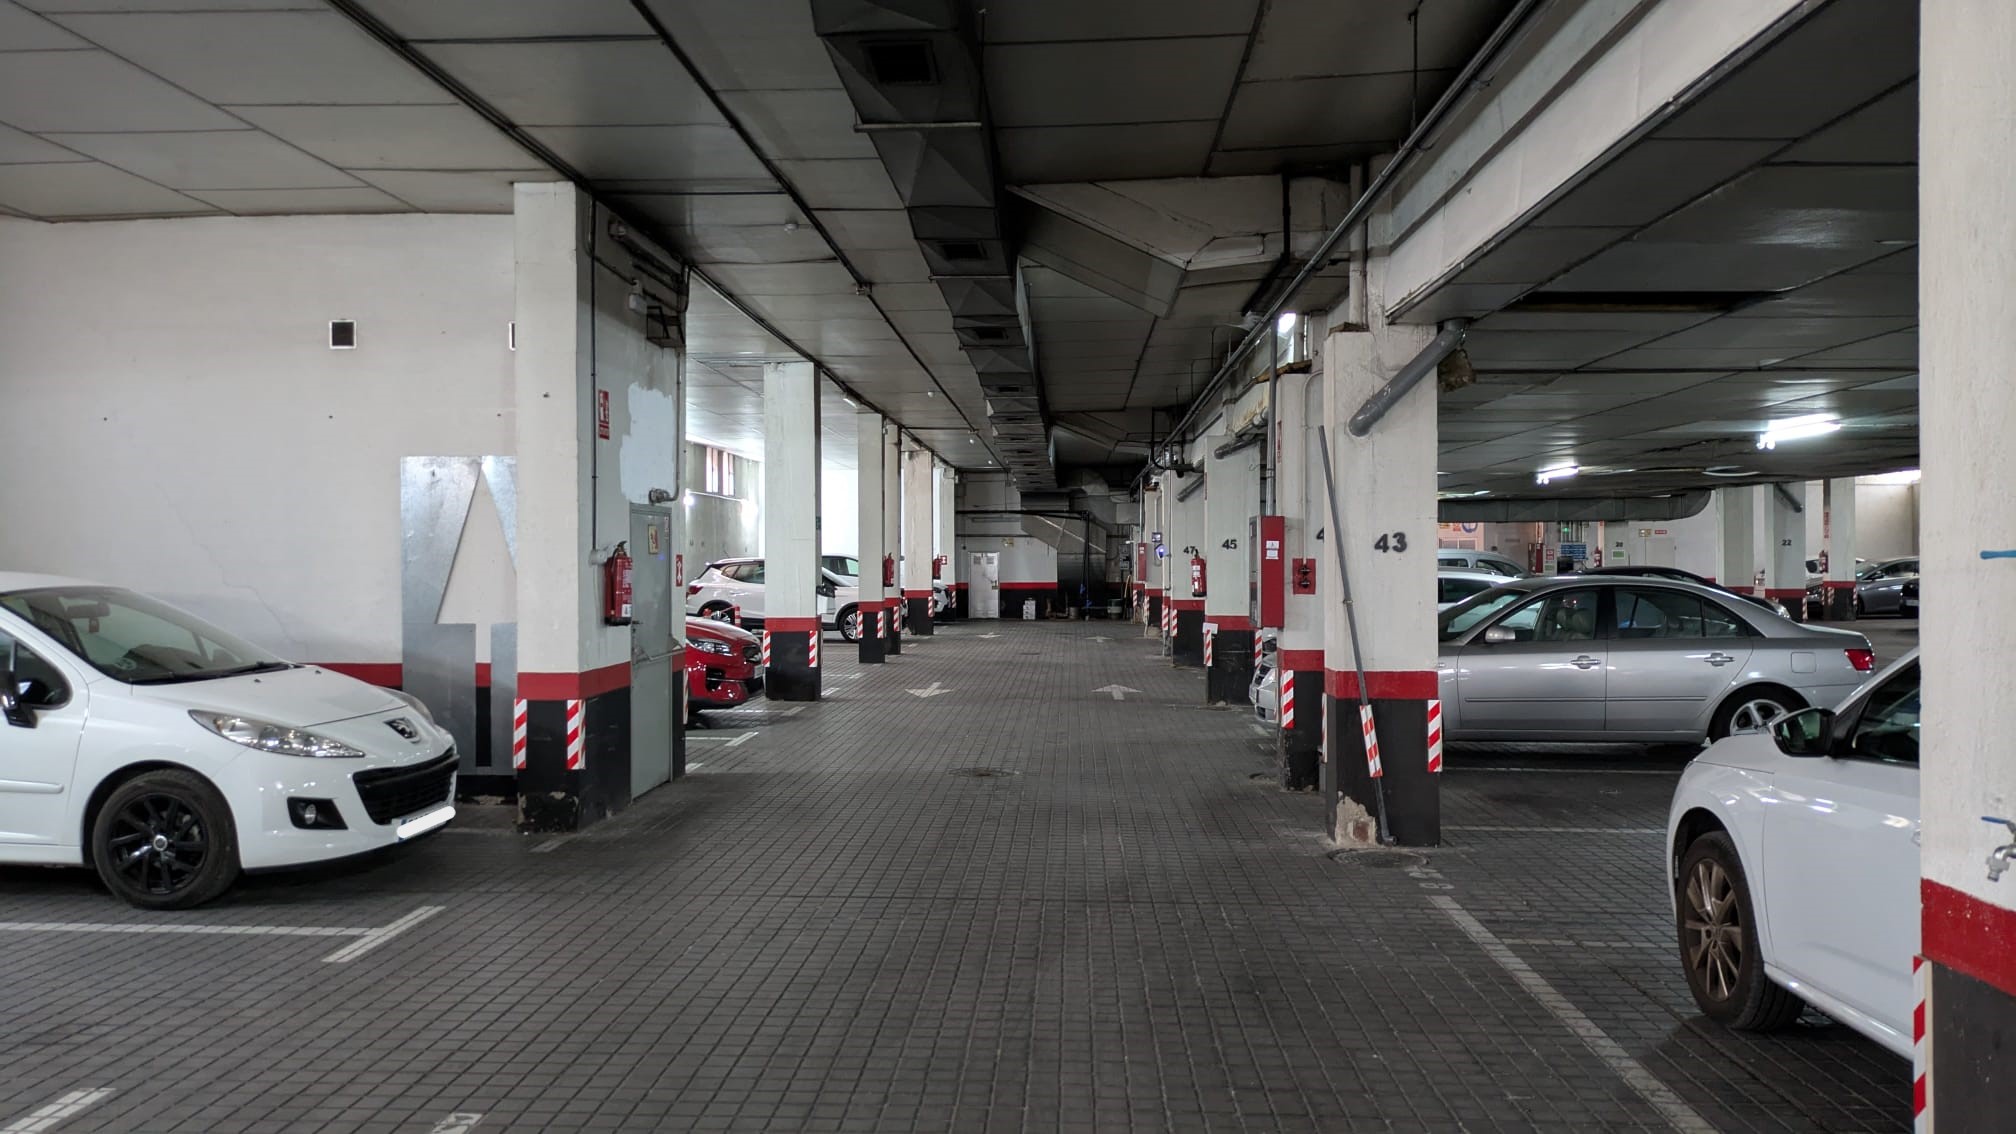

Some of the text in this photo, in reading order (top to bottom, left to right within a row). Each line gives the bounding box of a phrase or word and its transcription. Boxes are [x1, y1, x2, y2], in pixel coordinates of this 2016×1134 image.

[1222, 539, 1237, 550] 45
[1374, 532, 1407, 553] 43
[1183, 545, 1196, 554] 47
